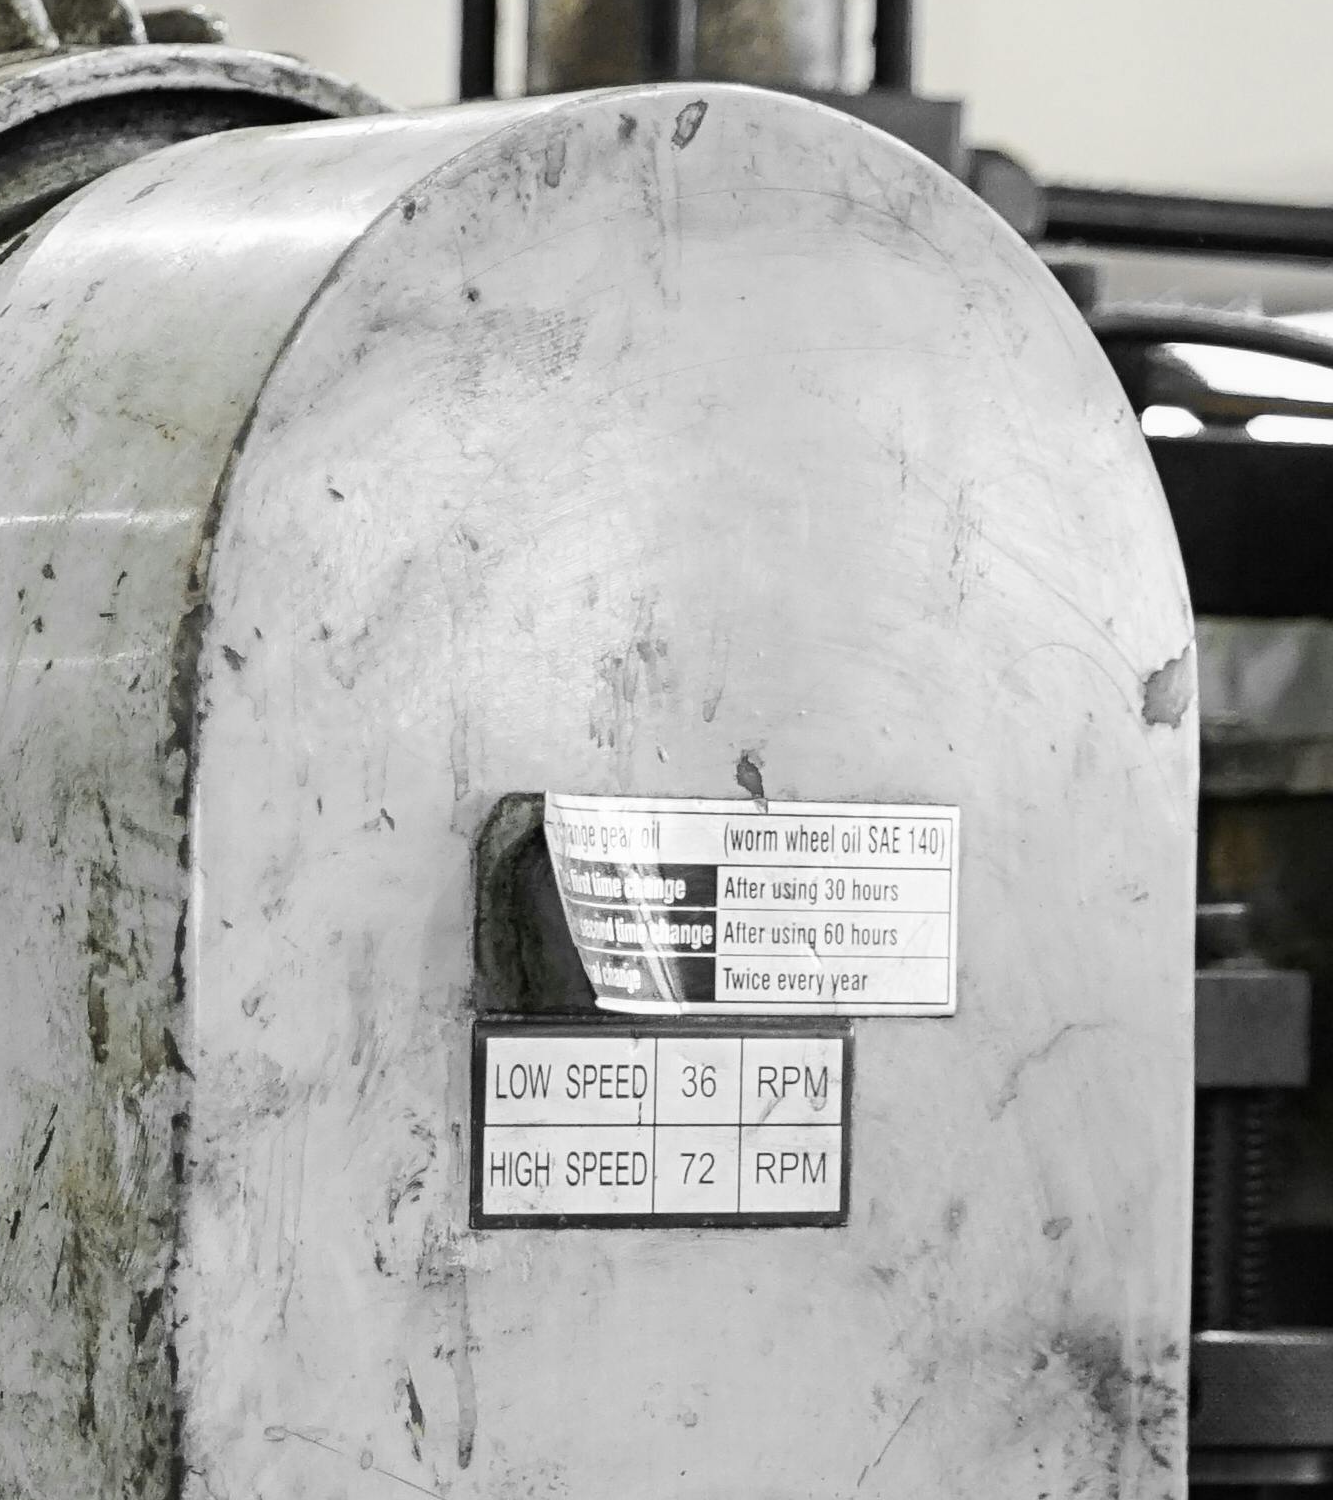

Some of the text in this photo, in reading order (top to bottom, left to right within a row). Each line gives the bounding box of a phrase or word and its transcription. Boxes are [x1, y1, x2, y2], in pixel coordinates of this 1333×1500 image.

[555, 817, 946, 861] hange gear oil (worm wheel oil SAE 140)
[593, 871, 623, 898] time
[623, 872, 687, 905] change
[724, 876, 899, 905] After using 30 hours
[615, 917, 647, 944] time
[649, 917, 714, 950] change
[723, 921, 898, 949] After using 60 hours
[723, 967, 868, 996] Twice every year
[495, 1064, 828, 1099] LOW SPEED 36 RPM
[490, 1151, 827, 1186] HIGH SPEED 72 RPM
